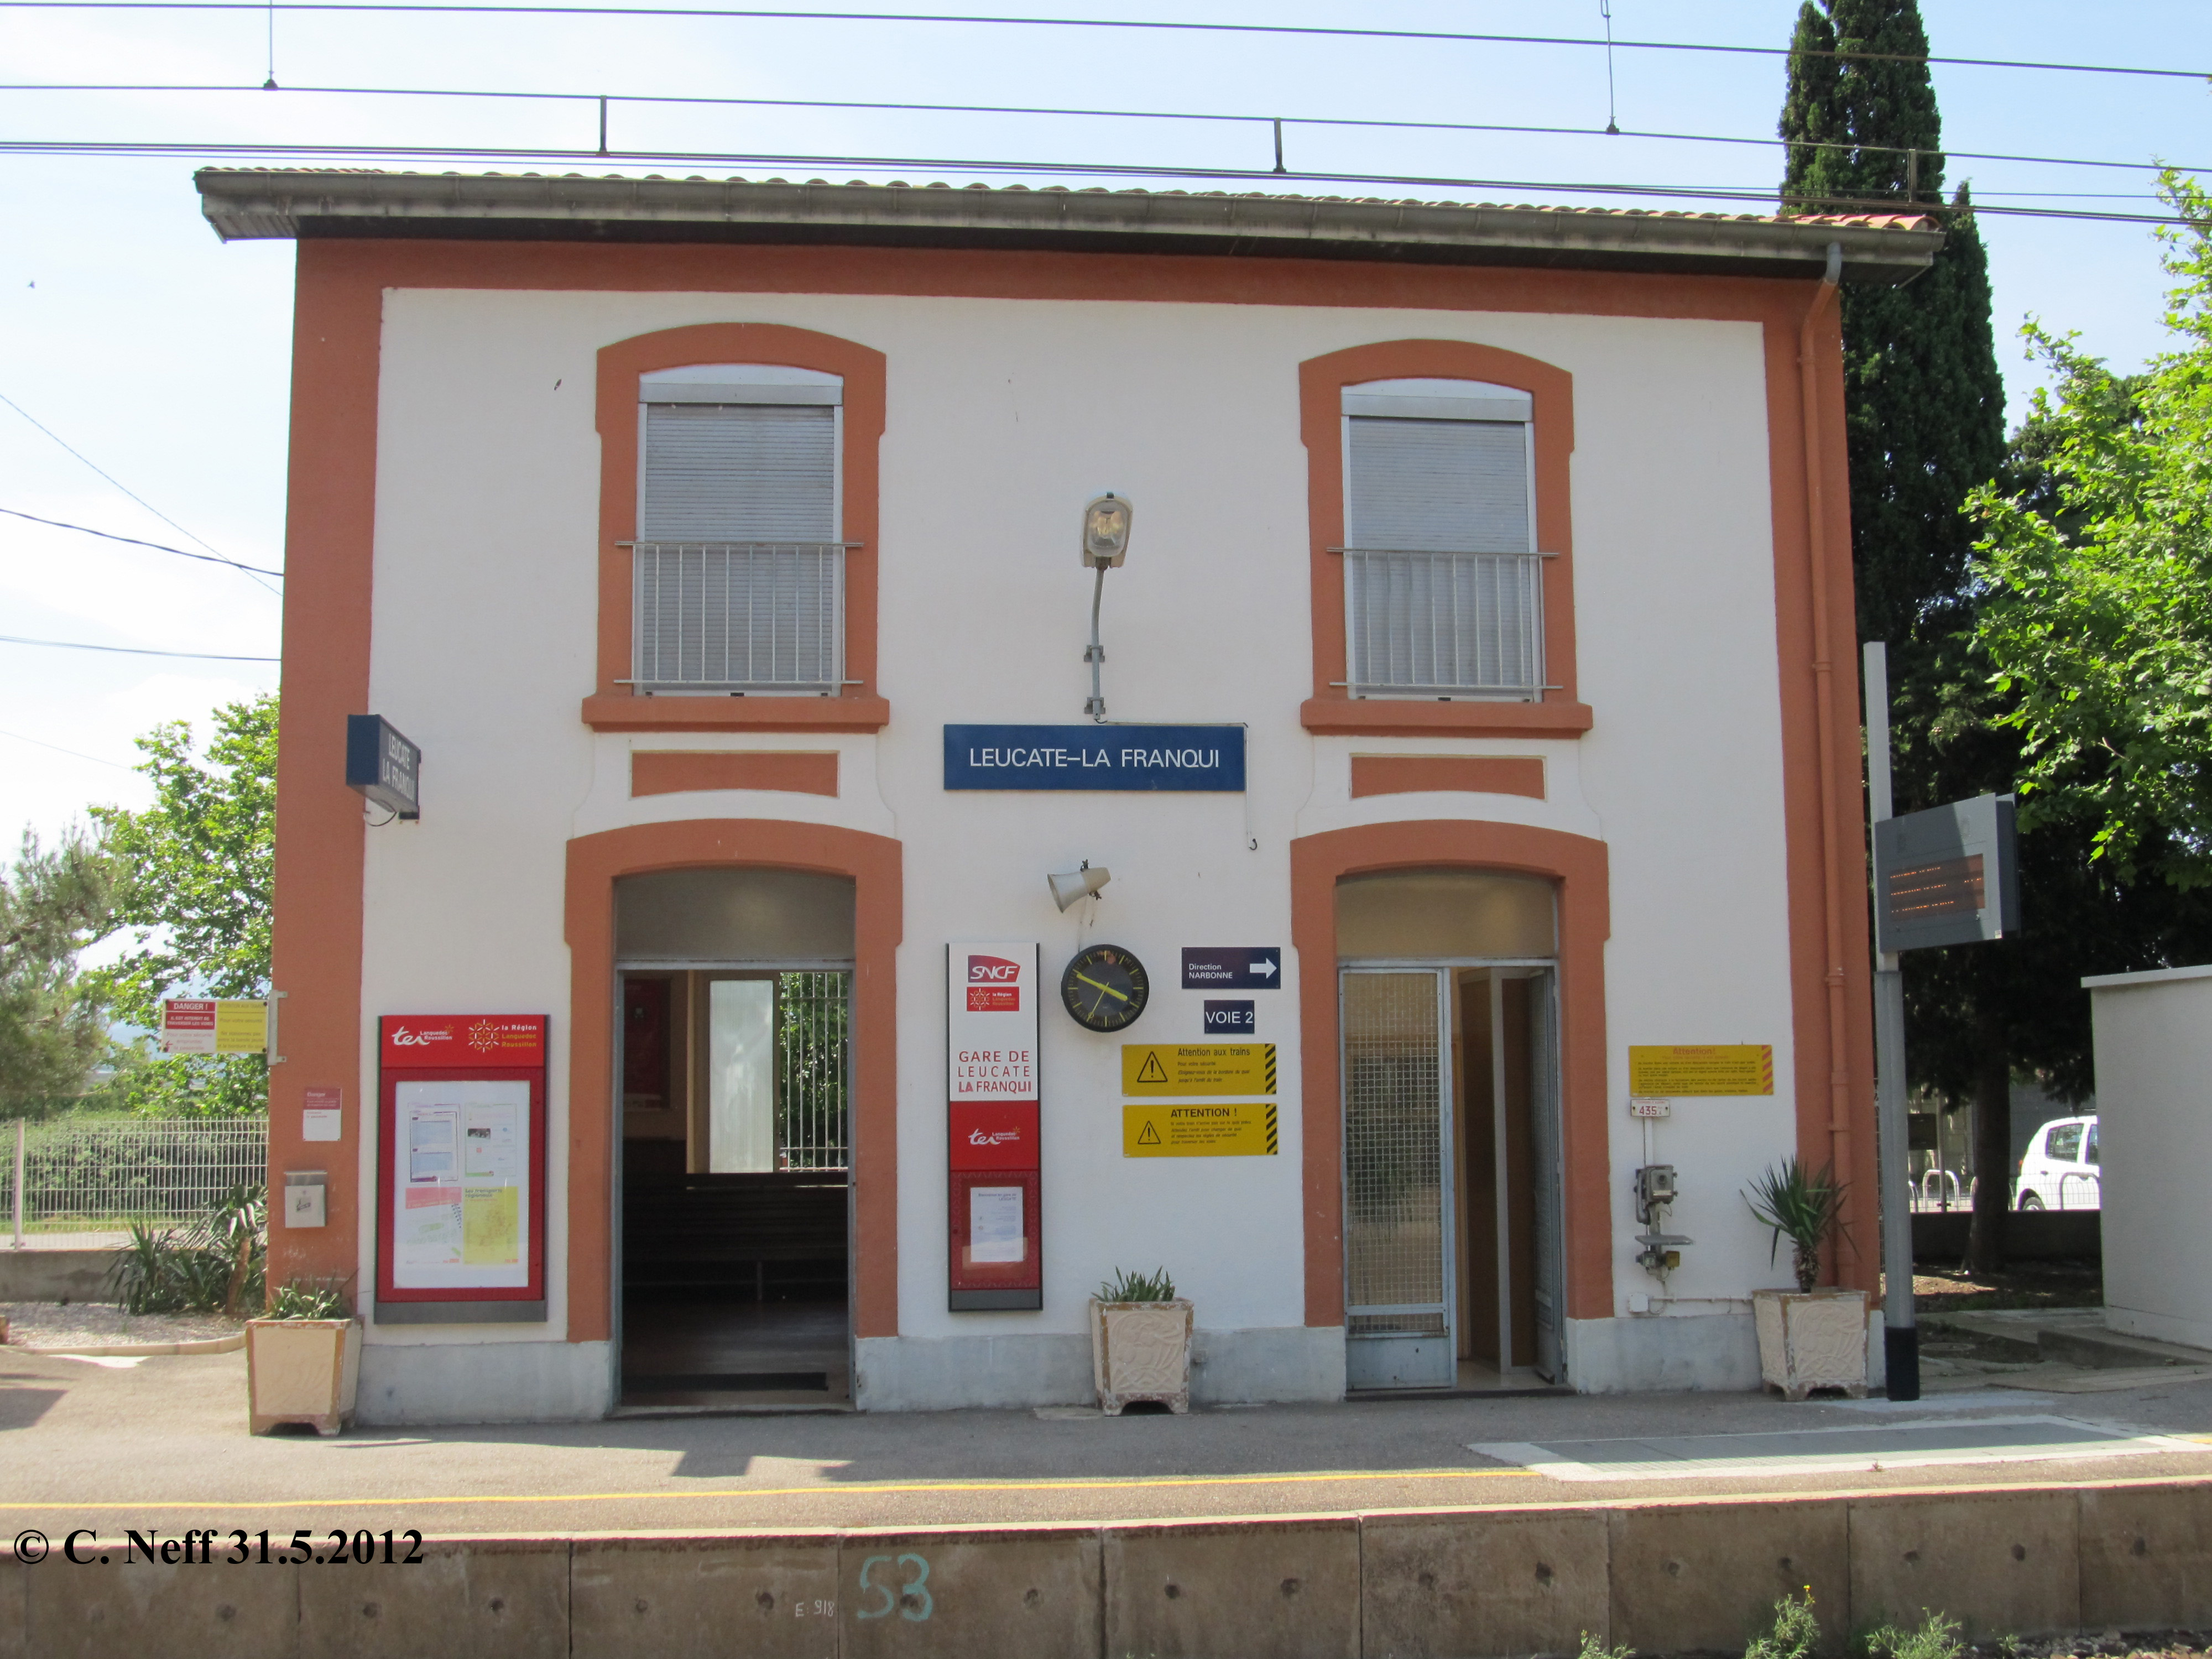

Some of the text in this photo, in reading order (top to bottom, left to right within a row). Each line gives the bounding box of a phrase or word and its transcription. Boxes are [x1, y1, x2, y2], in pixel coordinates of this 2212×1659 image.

[388, 733, 410, 770] LEUCATE
[1121, 749, 1219, 769] FRANQUI
[383, 758, 414, 802] LA FRANQUI
[970, 966, 1018, 979] SNCF
[1206, 1011, 1253, 1024] VOIE 2
[392, 1026, 431, 1045] ter
[959, 1051, 1029, 1062] GARE DE
[1177, 1047, 1211, 1056] Attention
[1230, 1047, 1250, 1056] trains
[958, 1066, 1030, 1077] LEUCATE
[958, 1081, 1031, 1093] LA FRANQUI
[1171, 1108, 1237, 1118] ATTENTION !
[1639, 1106, 1657, 1115] 435
[968, 1128, 1001, 1145] ter
[857, 1553, 933, 1621] 53
